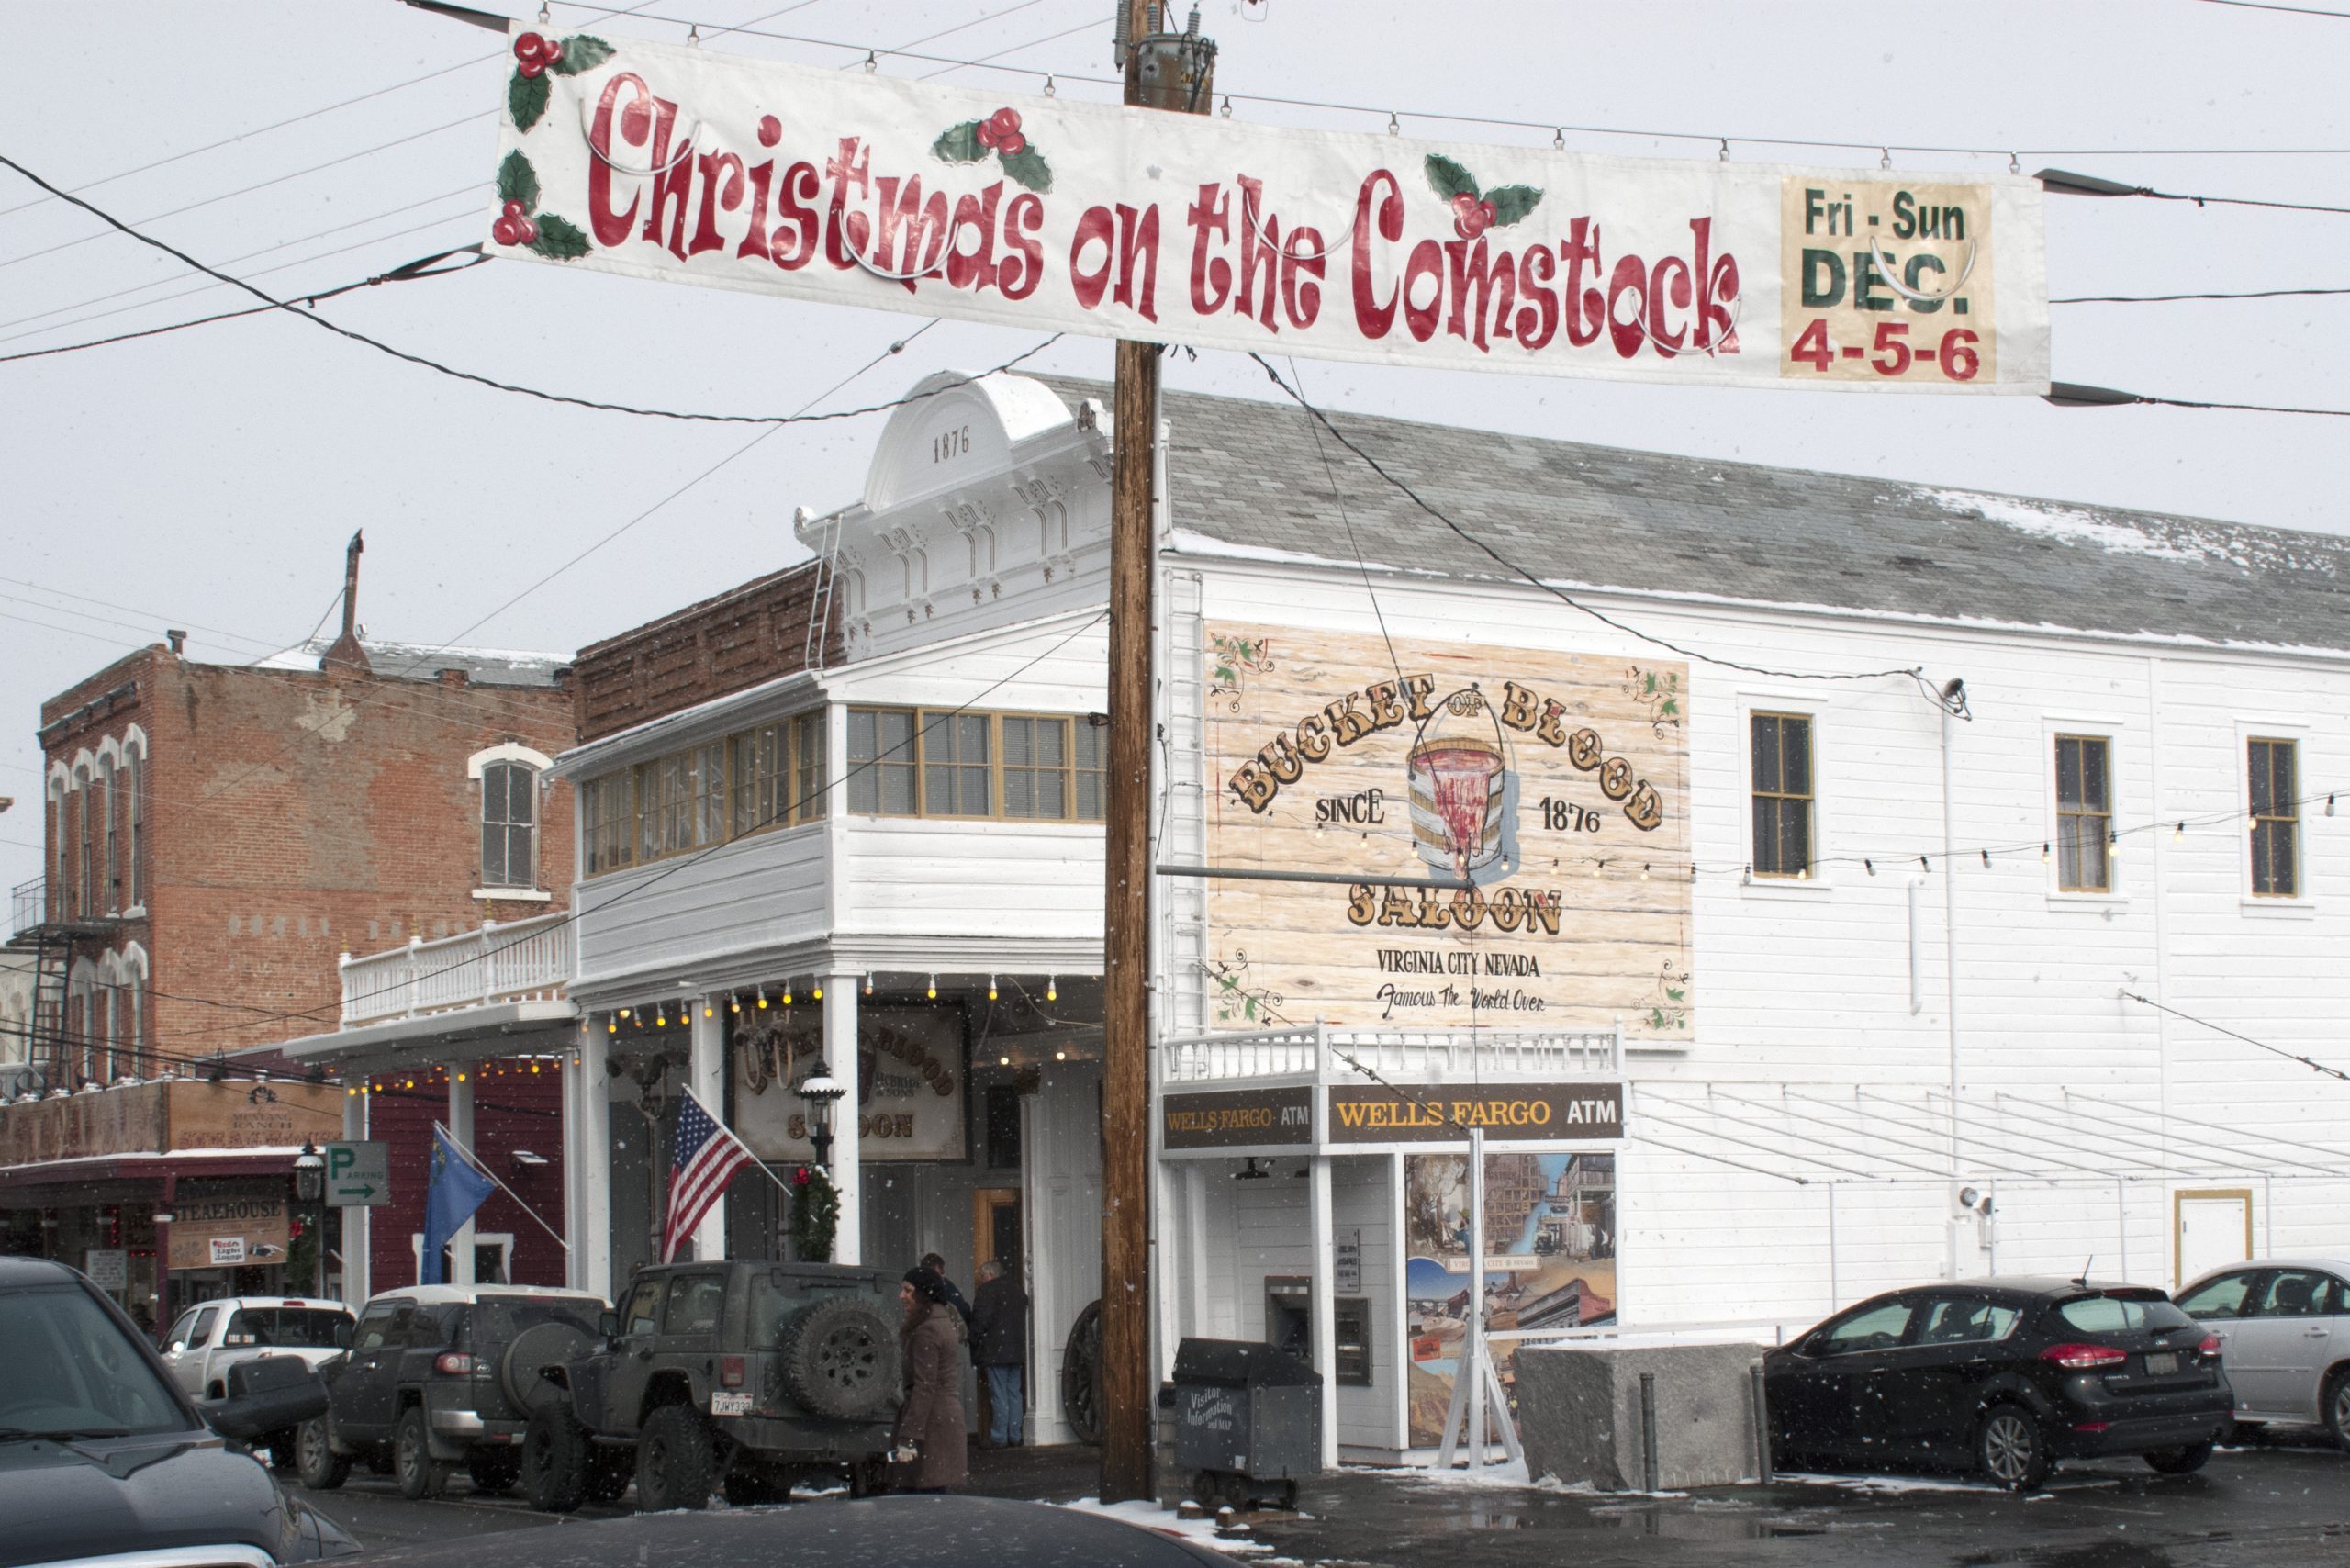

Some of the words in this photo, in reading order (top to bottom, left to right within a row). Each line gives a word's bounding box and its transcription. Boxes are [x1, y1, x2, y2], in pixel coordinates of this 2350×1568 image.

[589, 73, 1045, 301] Christmas
[1070, 203, 1158, 324] on
[1188, 174, 1326, 334] the
[1352, 169, 1740, 359] Comstock
[1805, 188, 1852, 237] Fri
[1892, 190, 1964, 241] Sun
[1801, 248, 1968, 315] DEC.
[1791, 319, 1980, 381] 4-5-6
[934, 425, 969, 464] 1876
[1228, 673, 1435, 814] BUCKET
[1447, 693, 1486, 717] OF
[1501, 681, 1662, 832] BLOOD
[1315, 788, 1385, 824] SINCE
[1539, 797, 1600, 833] 1876
[1348, 884, 1561, 935] SALOON
[1377, 949, 1446, 974] VIRGINIA
[1448, 952, 1480, 975] CITY
[1484, 953, 1540, 978] NEVADA
[1377, 983, 1435, 1019] Famous
[1438, 983, 1462, 1007] The
[1471, 987, 1510, 1010] World
[1515, 989, 1546, 1012] Over
[876, 1026, 955, 1096] BLOOD
[1167, 1110, 1217, 1131] WELLS
[1220, 1107, 1272, 1129] FARGO
[1281, 1105, 1308, 1126] ATM
[1337, 1101, 1444, 1127] WELLS
[1451, 1100, 1550, 1126] FARGO
[1567, 1100, 1616, 1124] ATM
[1187, 1398, 1232, 1426] Information
[1191, 1387, 1221, 1409] Visitor
